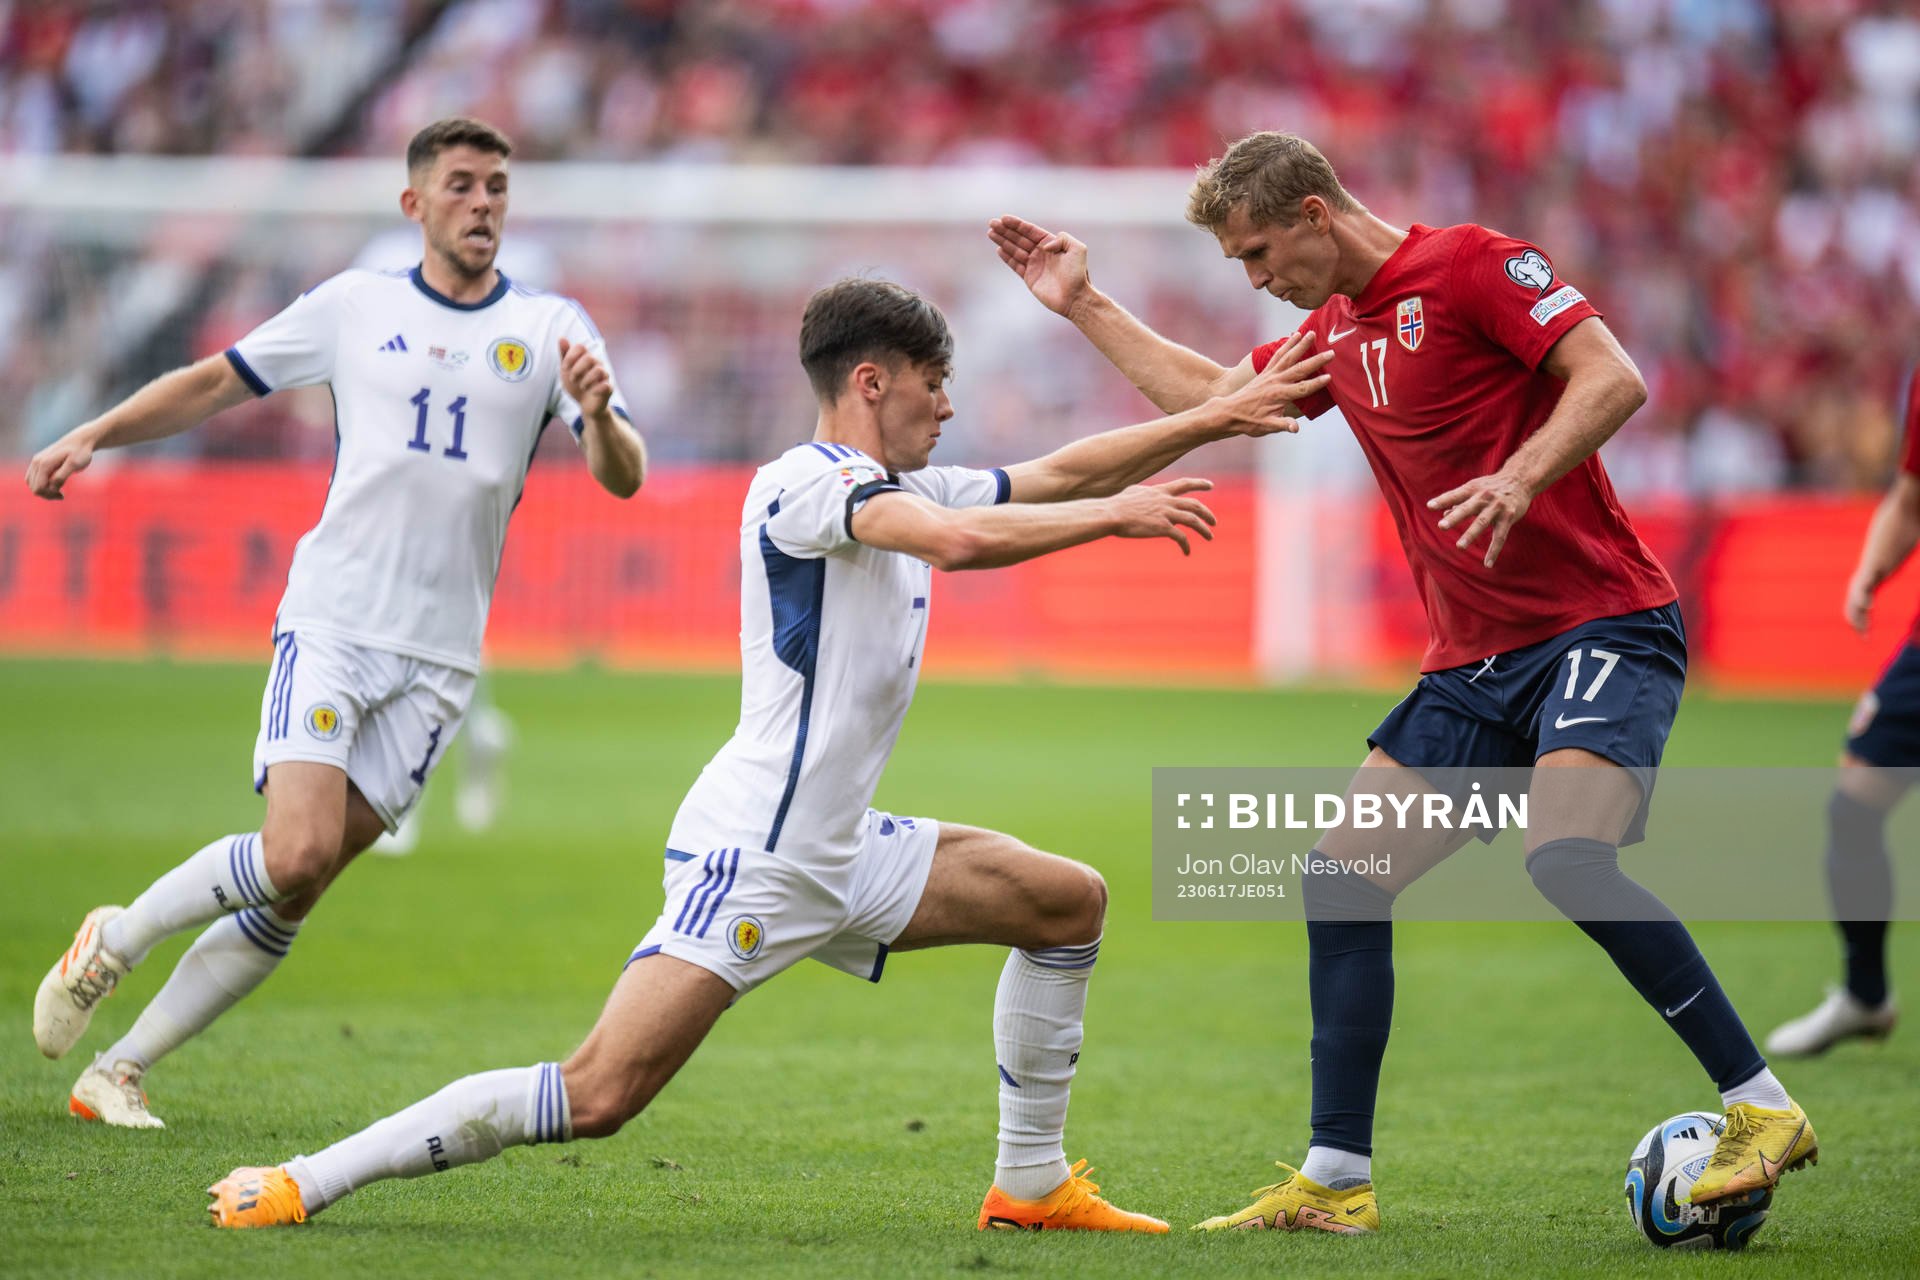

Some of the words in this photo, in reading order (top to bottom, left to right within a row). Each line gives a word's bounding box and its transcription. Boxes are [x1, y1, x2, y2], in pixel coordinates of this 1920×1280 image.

[1359, 337, 1389, 409] 17
[407, 386, 468, 462] 11
[1563, 648, 1622, 702] 17
